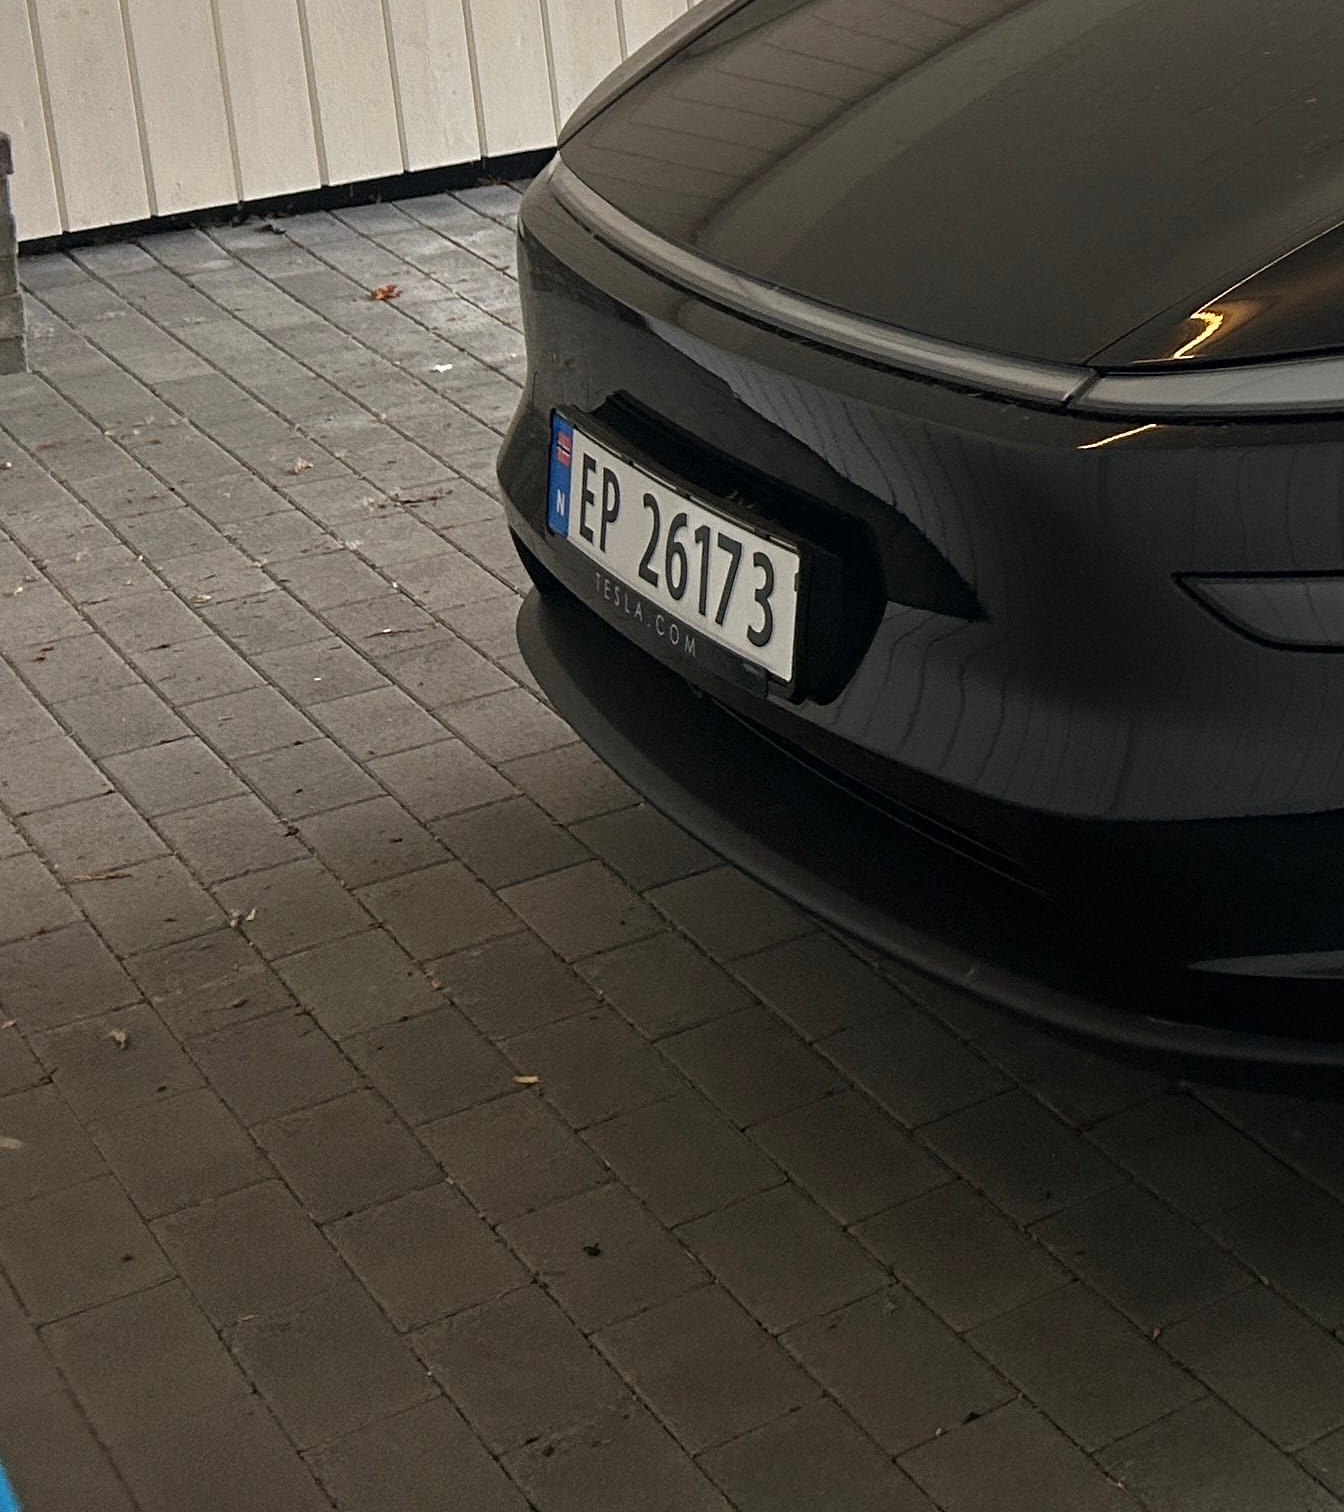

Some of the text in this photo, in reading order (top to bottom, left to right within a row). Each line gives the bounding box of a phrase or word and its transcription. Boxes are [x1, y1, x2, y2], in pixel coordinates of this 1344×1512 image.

[555, 489, 566, 517] N
[578, 453, 776, 649] EP 26173
[594, 571, 698, 659] TESLA.COM
